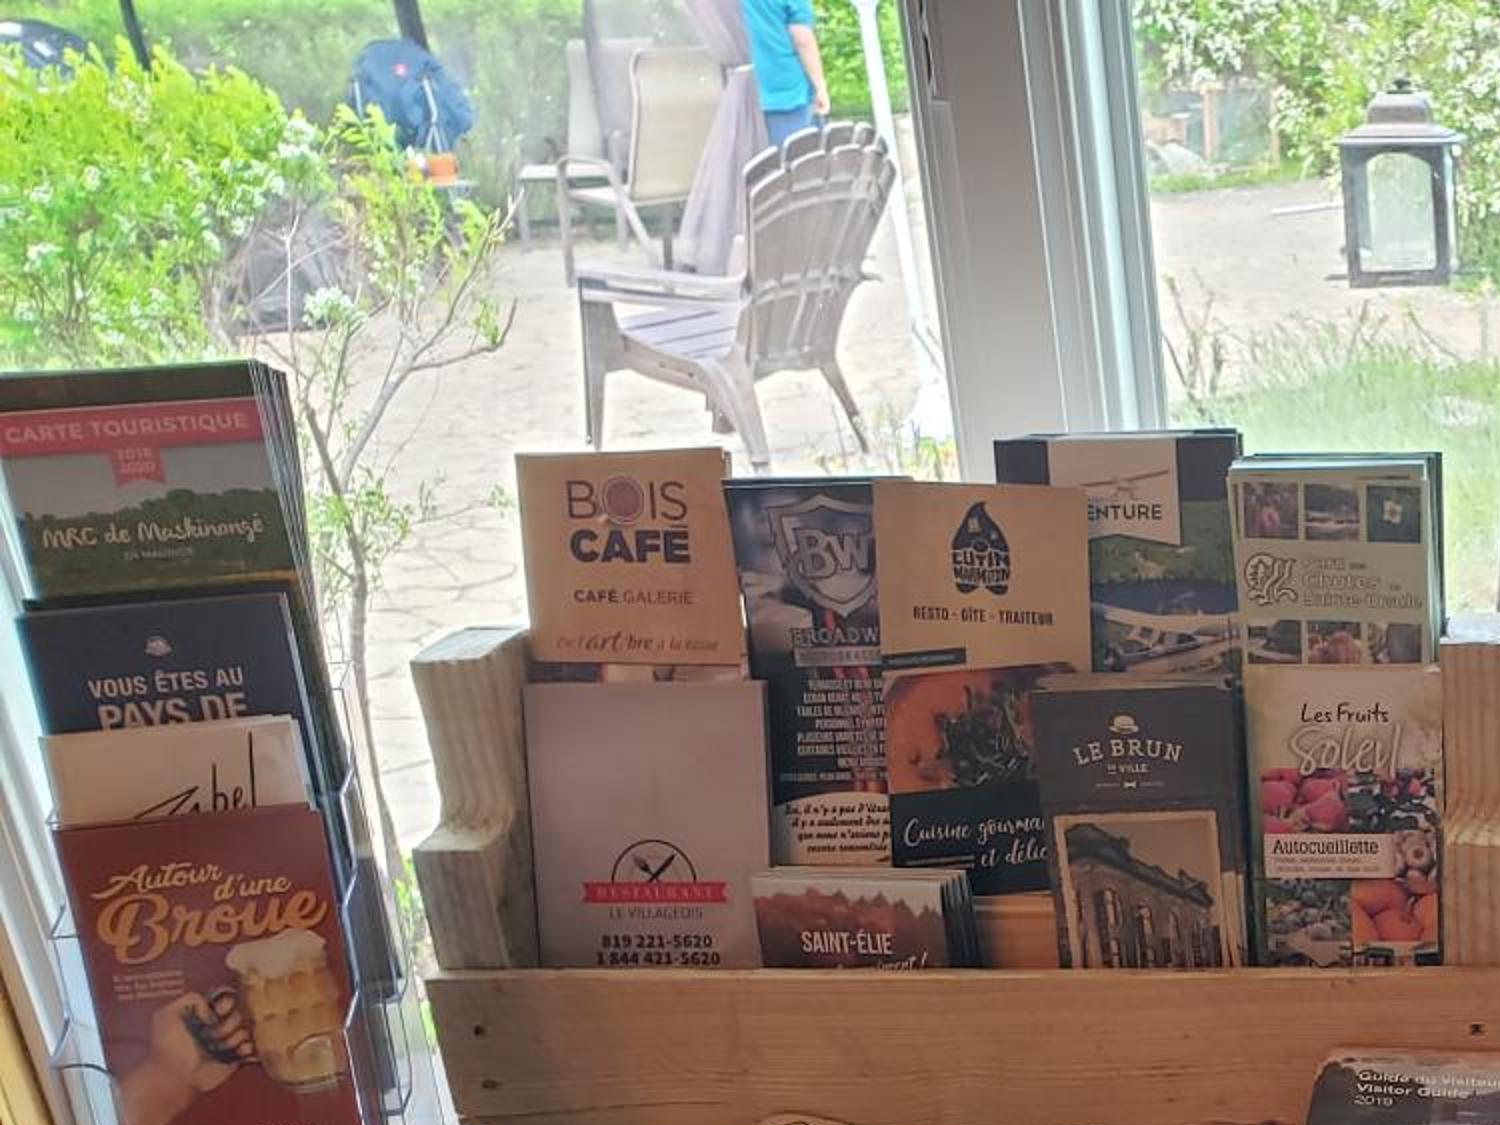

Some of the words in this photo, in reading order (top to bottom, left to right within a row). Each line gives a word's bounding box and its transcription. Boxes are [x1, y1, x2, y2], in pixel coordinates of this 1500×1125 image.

[4, 422, 84, 444] CARTE
[92, 411, 250, 438] TOURISTIQUE
[565, 476, 688, 525] BOIS
[1088, 503, 1163, 521] ENTURE
[41, 527, 98, 550] MRC
[103, 521, 132, 544] de
[137, 512, 267, 543] Maskinongé
[569, 524, 692, 564] CAFÉ
[623, 590, 695, 605] GALERIE
[913, 605, 949, 622] RESTO
[999, 609, 1054, 626] TRAITEUR
[790, 626, 880, 646] BROADW
[88, 676, 148, 698] VOUS
[154, 668, 208, 693] ÊTES
[215, 666, 244, 686] AU
[97, 699, 192, 731] PAYS
[200, 691, 248, 721] DE
[1300, 703, 1333, 724] Les
[1337, 702, 1389, 724] Fruits
[1072, 740, 1105, 766] LE
[1110, 738, 1184, 763] BRUN
[904, 817, 971, 847] Cuisine
[977, 816, 1045, 845] gourma
[981, 848, 1000, 868] et
[1005, 837, 1049, 865] délic
[1272, 838, 1380, 857] Autocueillette
[92, 861, 223, 899] Autour
[214, 872, 292, 901] d'une
[627, 906, 704, 921] VILLAGEOIS
[96, 890, 328, 965] Broue
[602, 934, 632, 949] 819
[636, 933, 714, 949] 221-5620
[801, 929, 894, 955] SAINT-ÉLIE
[609, 951, 640, 966] 844
[643, 951, 722, 966] 421-5620
[1355, 1082, 1413, 1096] Visitor
[1416, 1086, 1471, 1099] Guide
